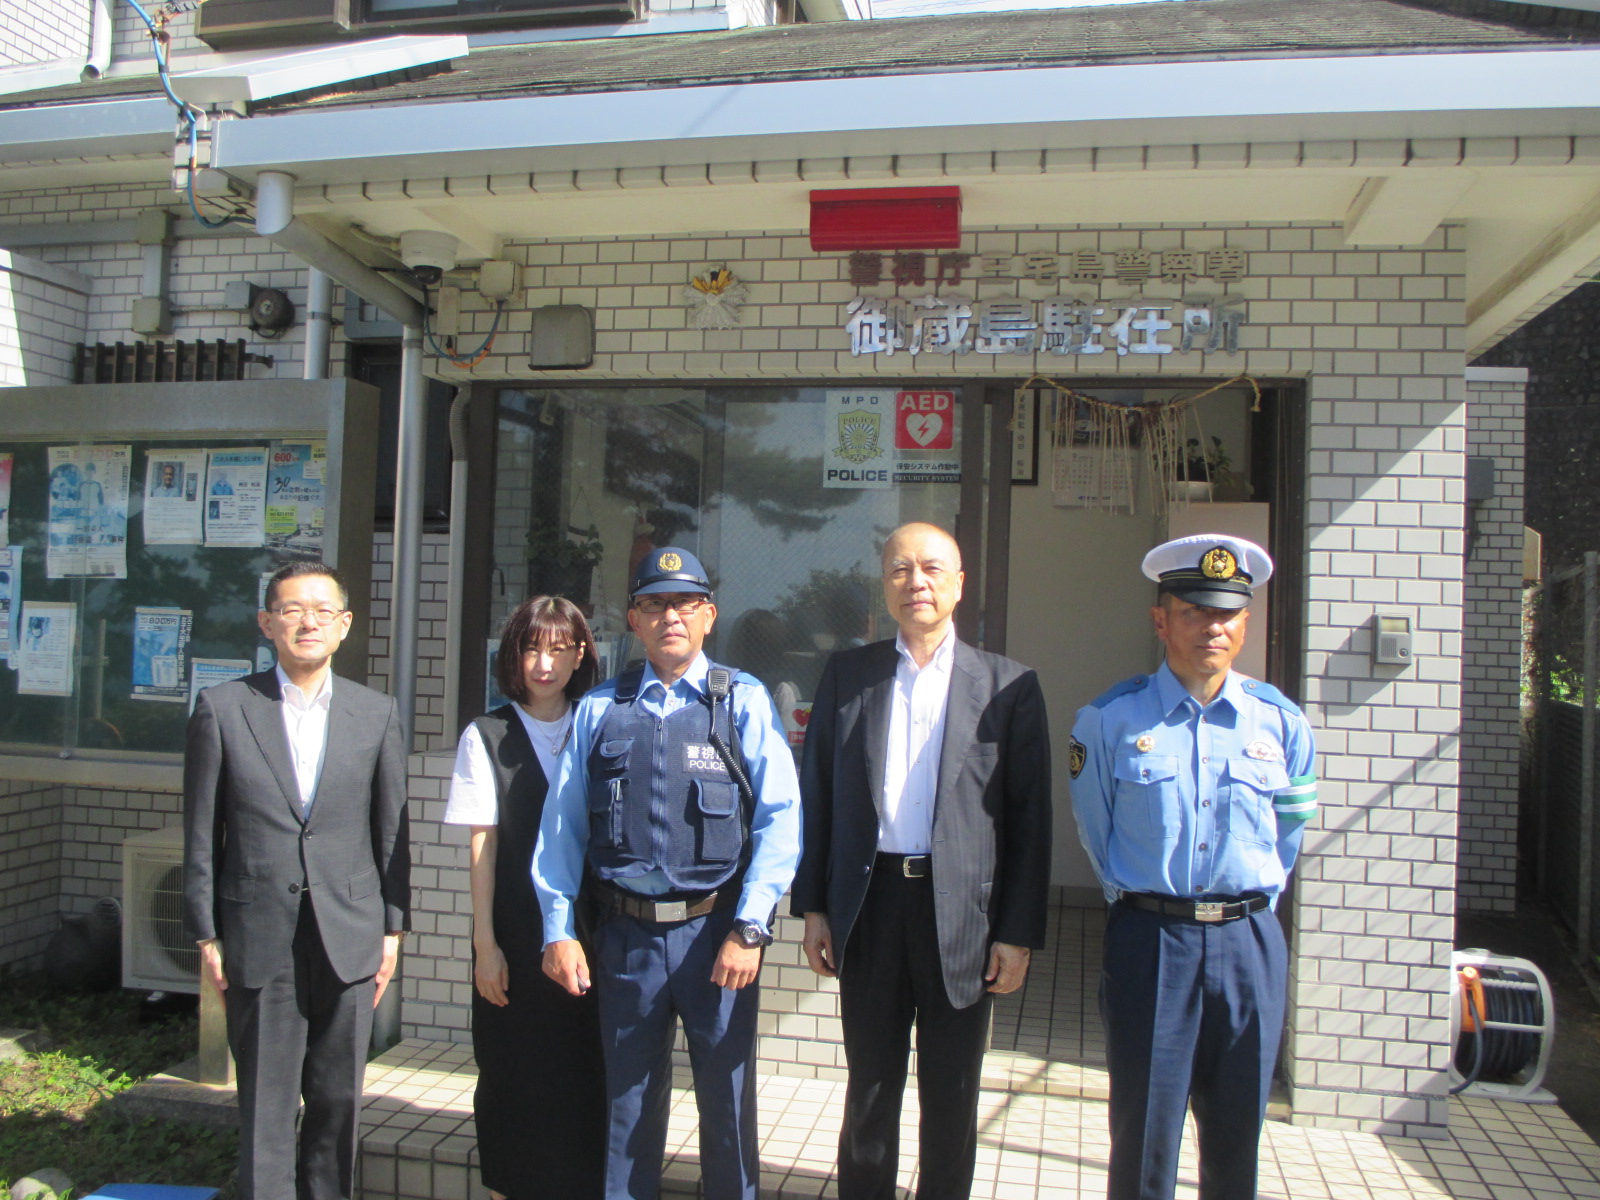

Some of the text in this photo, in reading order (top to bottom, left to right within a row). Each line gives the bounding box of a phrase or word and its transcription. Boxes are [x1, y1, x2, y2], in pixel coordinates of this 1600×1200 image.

[848, 248, 1245, 286] 警視庁三宅島警察署
[846, 294, 1245, 356] 御蔵島駐在所
[900, 394, 949, 411] AED
[896, 463, 960, 471] 保安システム作動中
[827, 470, 888, 481] POLICE
[687, 745, 721, 760] 警視
[690, 760, 726, 771] POLICE
